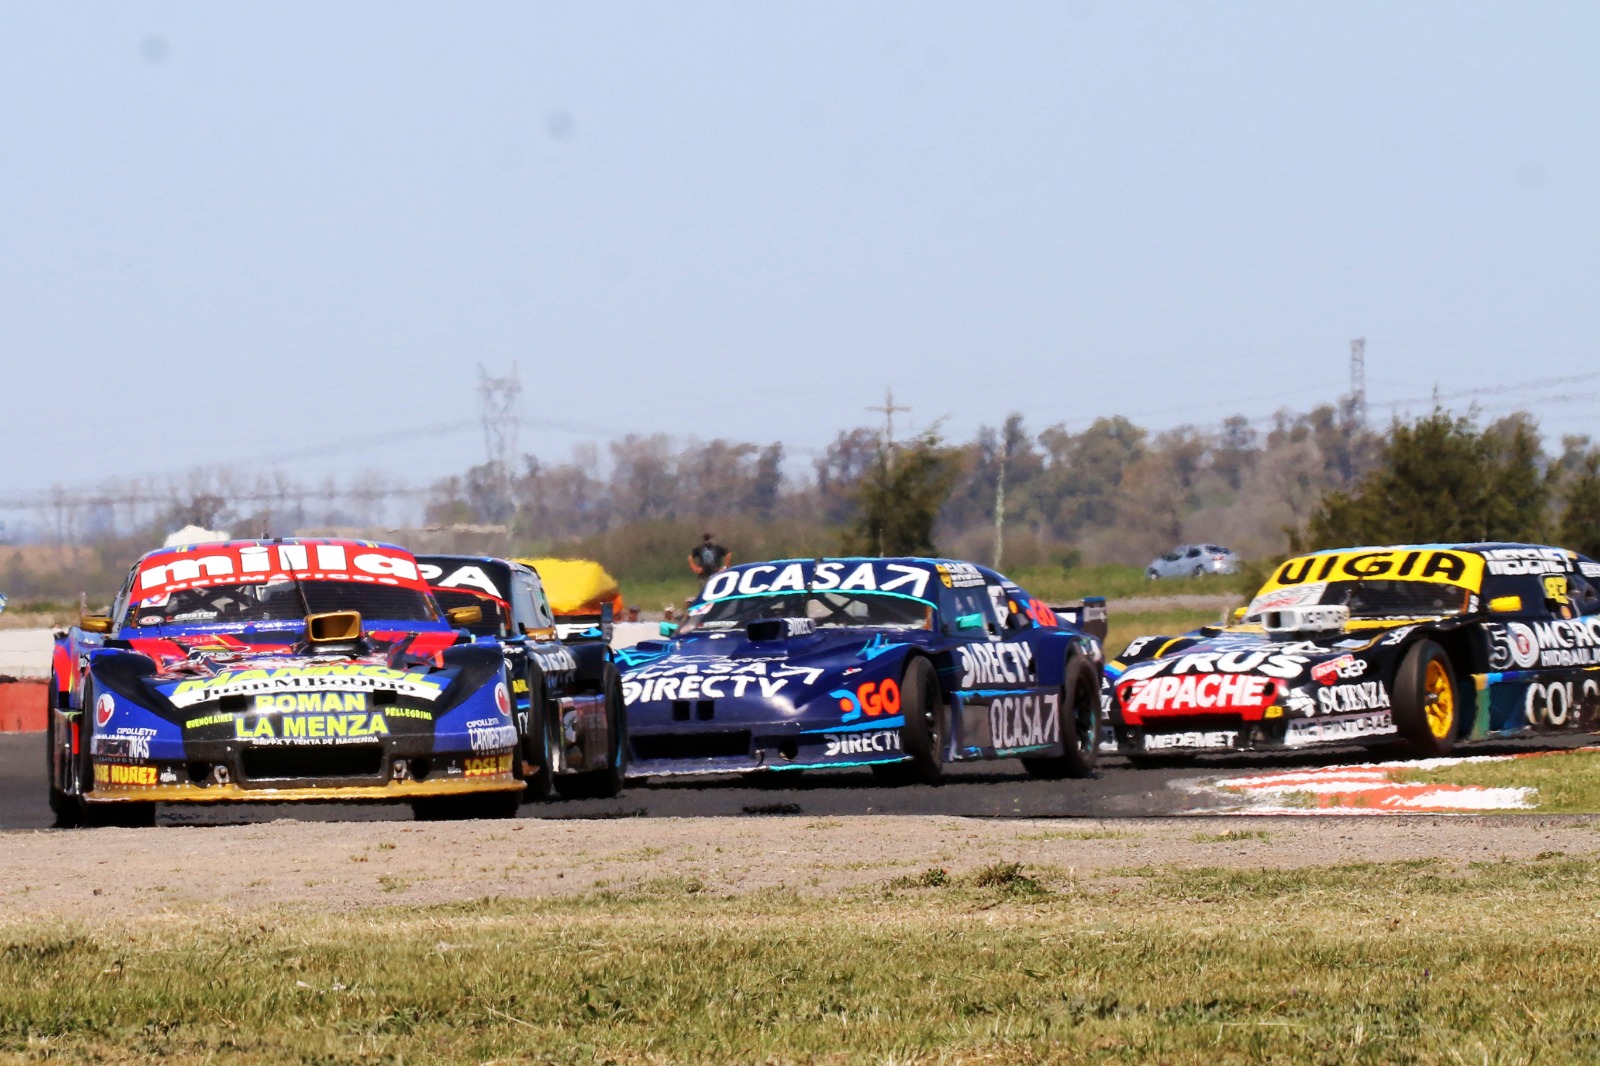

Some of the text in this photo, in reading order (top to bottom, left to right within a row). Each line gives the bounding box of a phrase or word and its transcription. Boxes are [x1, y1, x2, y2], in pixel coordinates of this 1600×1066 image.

[173, 665, 440, 695] MANNOL
[254, 692, 366, 713] ROMAN
[235, 713, 389, 738] LA MENZA
